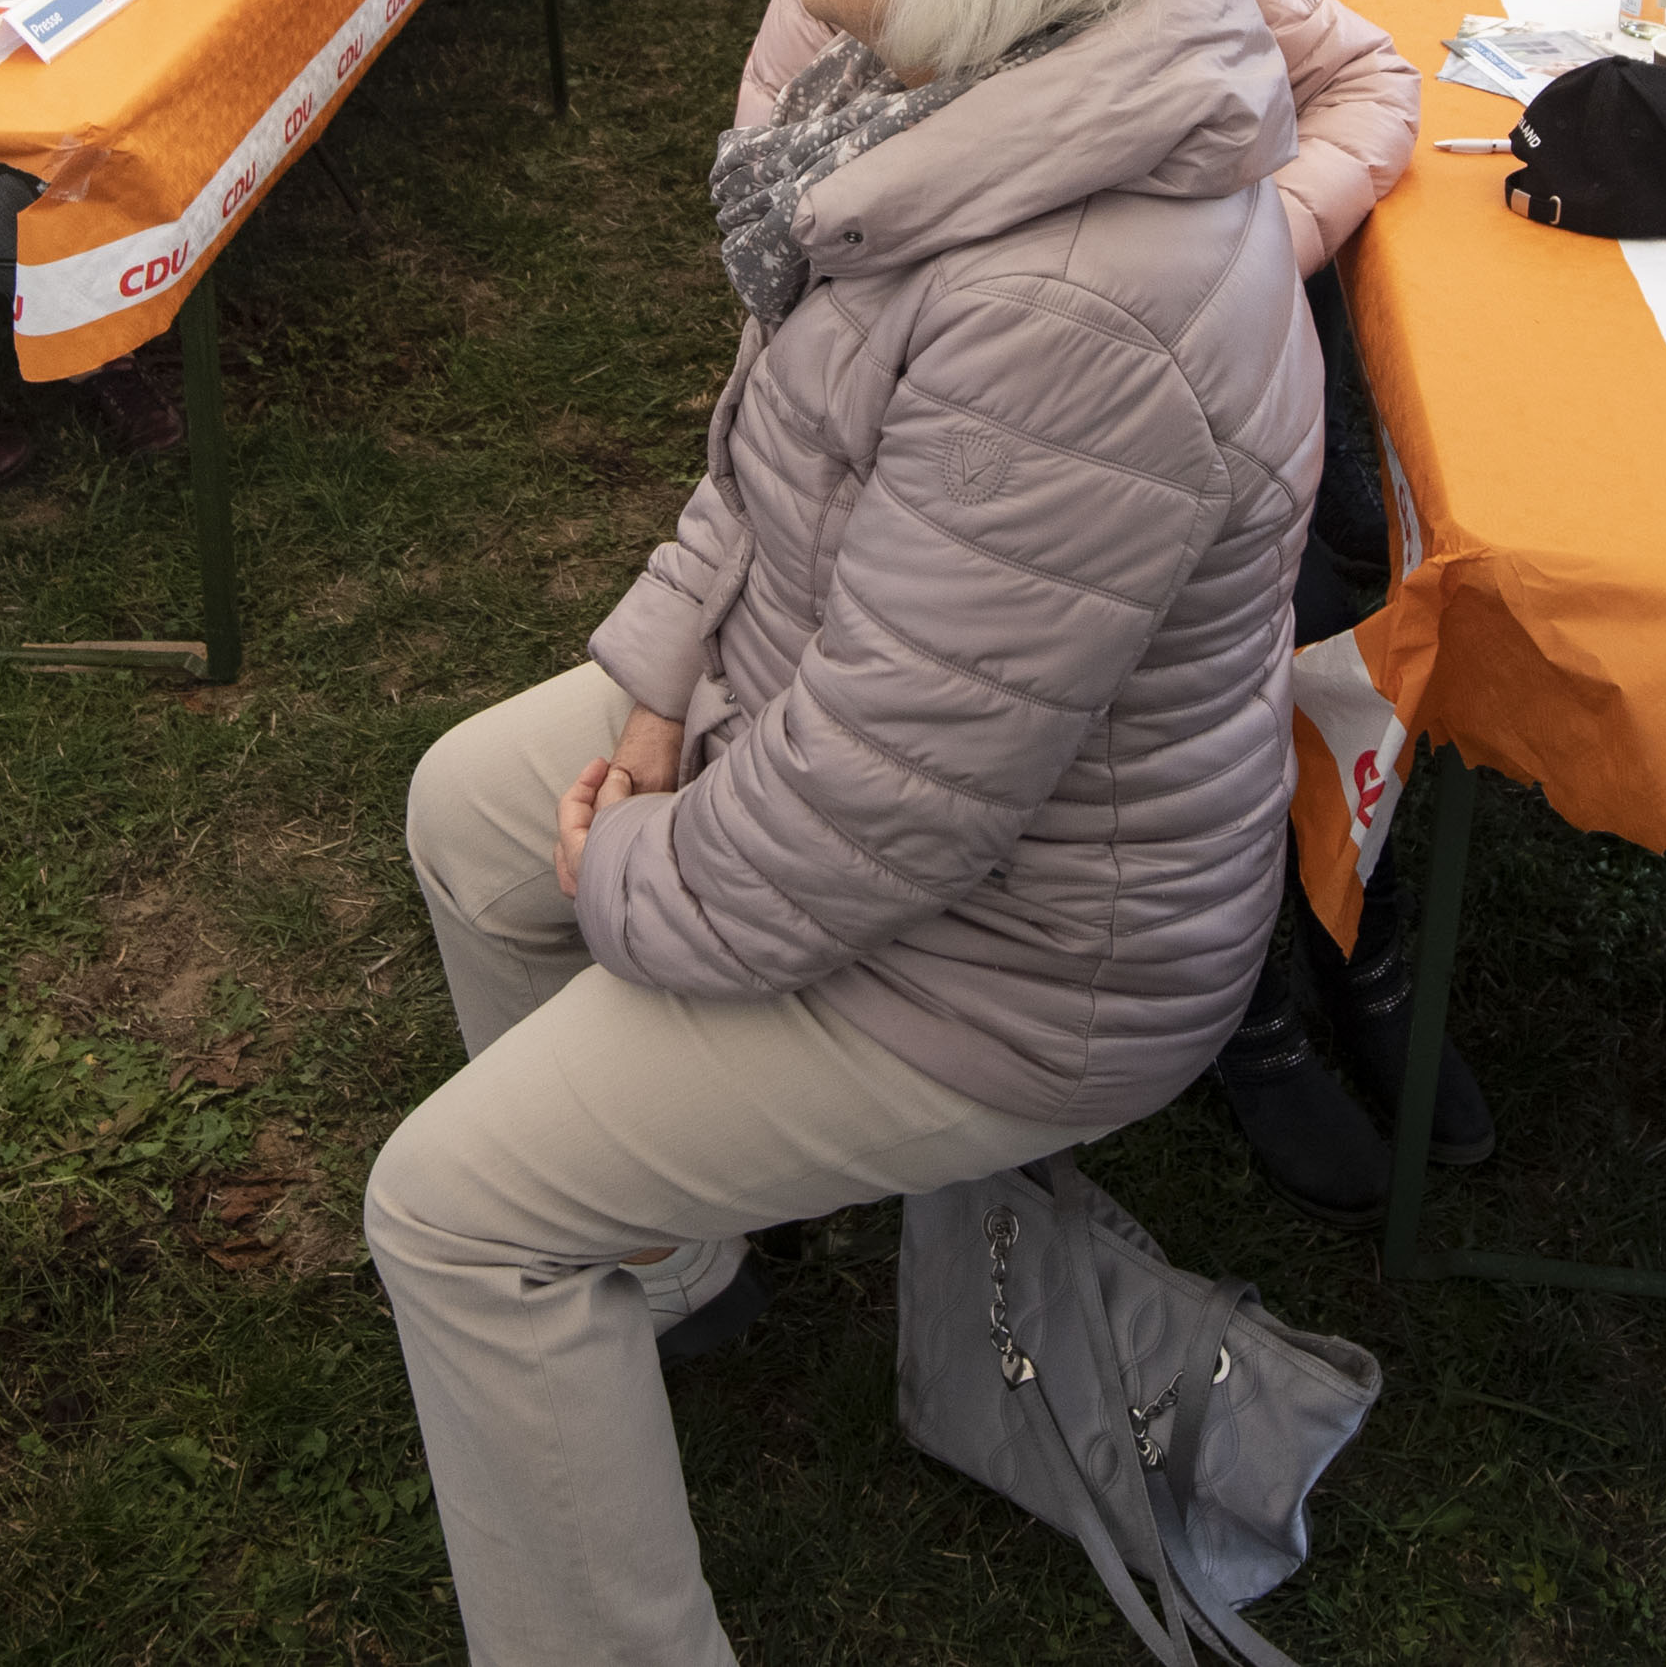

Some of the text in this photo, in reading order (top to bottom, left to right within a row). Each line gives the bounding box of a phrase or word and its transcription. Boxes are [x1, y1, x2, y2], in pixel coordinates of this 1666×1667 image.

[29, 11, 64, 39] Presse
[337, 34, 364, 80] CDU
[285, 92, 313, 144] CDU
[222, 161, 256, 218] CDU
[119, 239, 189, 298] CDU
